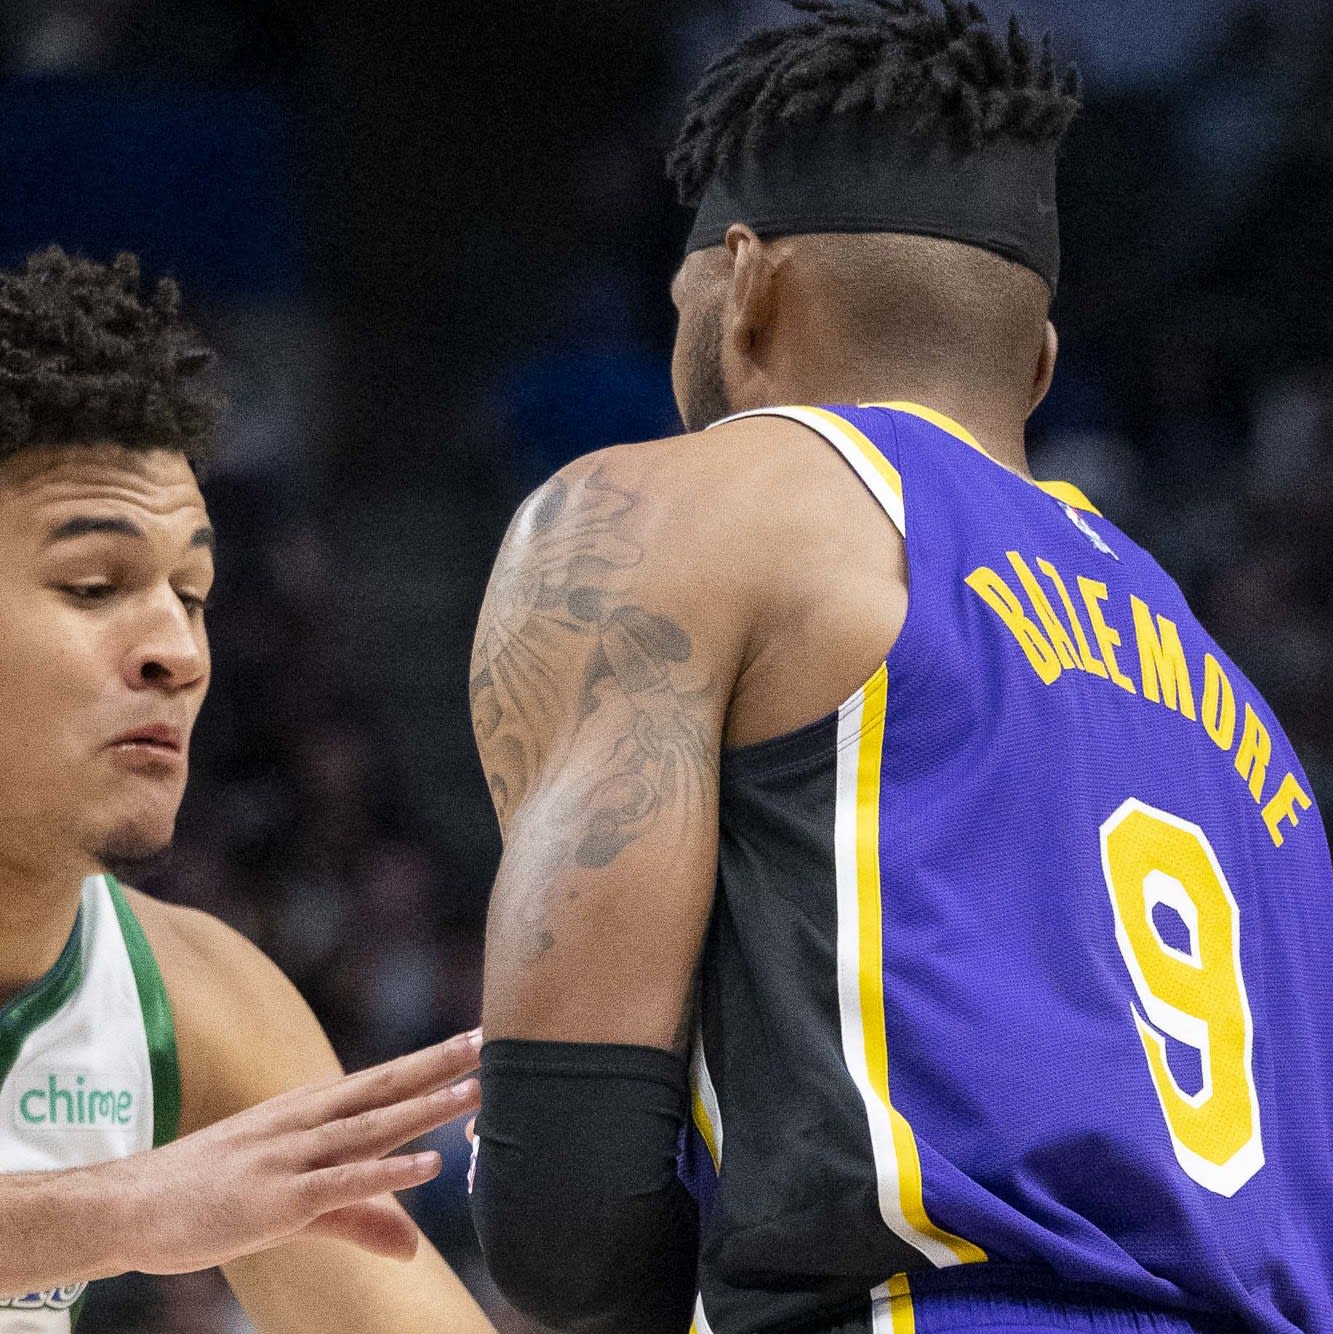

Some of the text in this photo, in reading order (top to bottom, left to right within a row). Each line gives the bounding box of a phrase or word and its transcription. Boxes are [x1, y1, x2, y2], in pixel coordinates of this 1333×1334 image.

[964, 551, 1312, 847] BAZEMORE
[19, 1075, 133, 1126] chime
[1099, 797, 1266, 1198] 9
